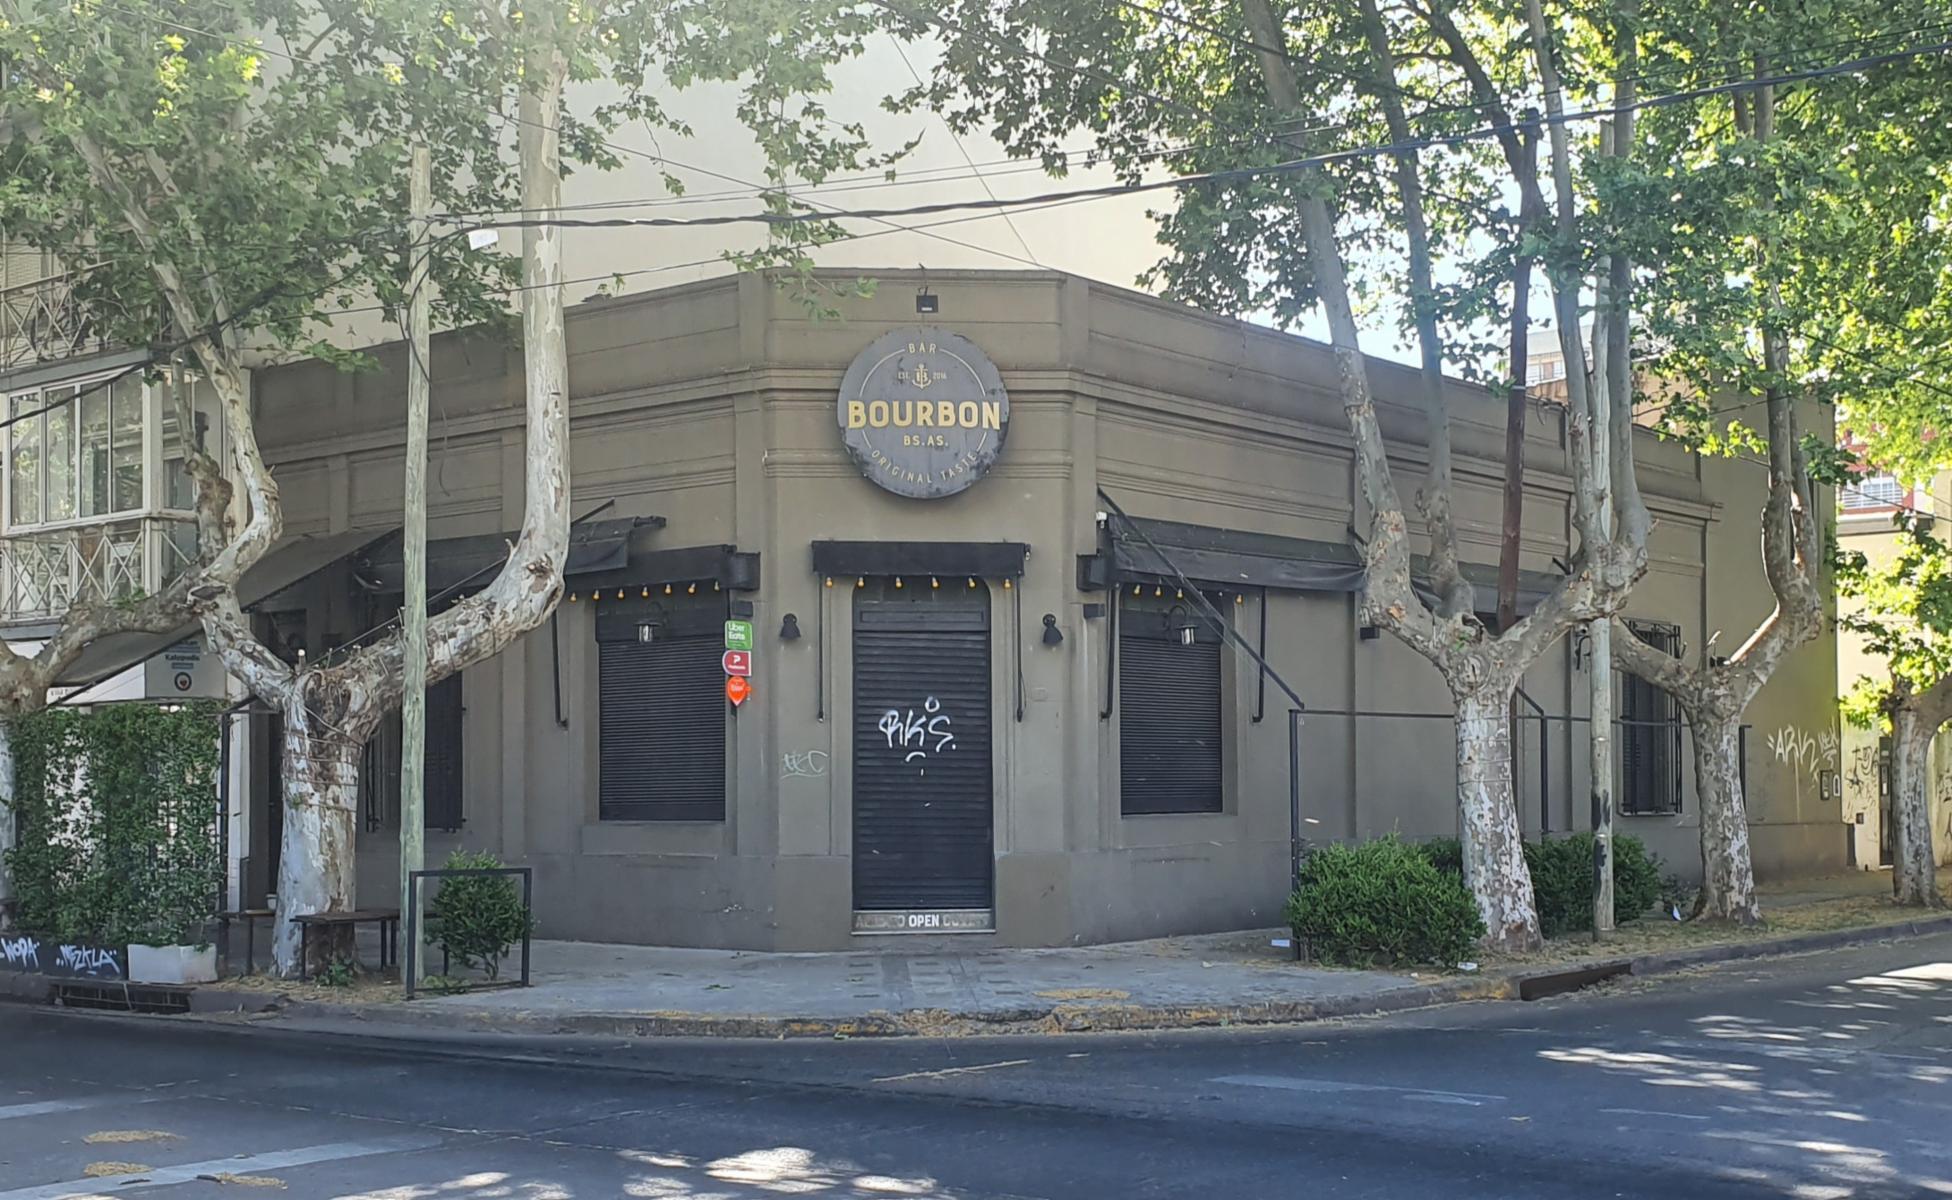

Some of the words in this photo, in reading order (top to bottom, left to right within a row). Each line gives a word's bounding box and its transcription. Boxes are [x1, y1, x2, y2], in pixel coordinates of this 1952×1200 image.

[908, 342, 937, 354] BAR
[848, 400, 1001, 430] BOURBON
[903, 435, 949, 447] BS.AS.
[871, 449, 933, 484] ORIGINAL
[940, 450, 978, 481] TASTE
[728, 622, 745, 632] Uber
[728, 631, 746, 640] Eats
[908, 914, 940, 928] OPEN
